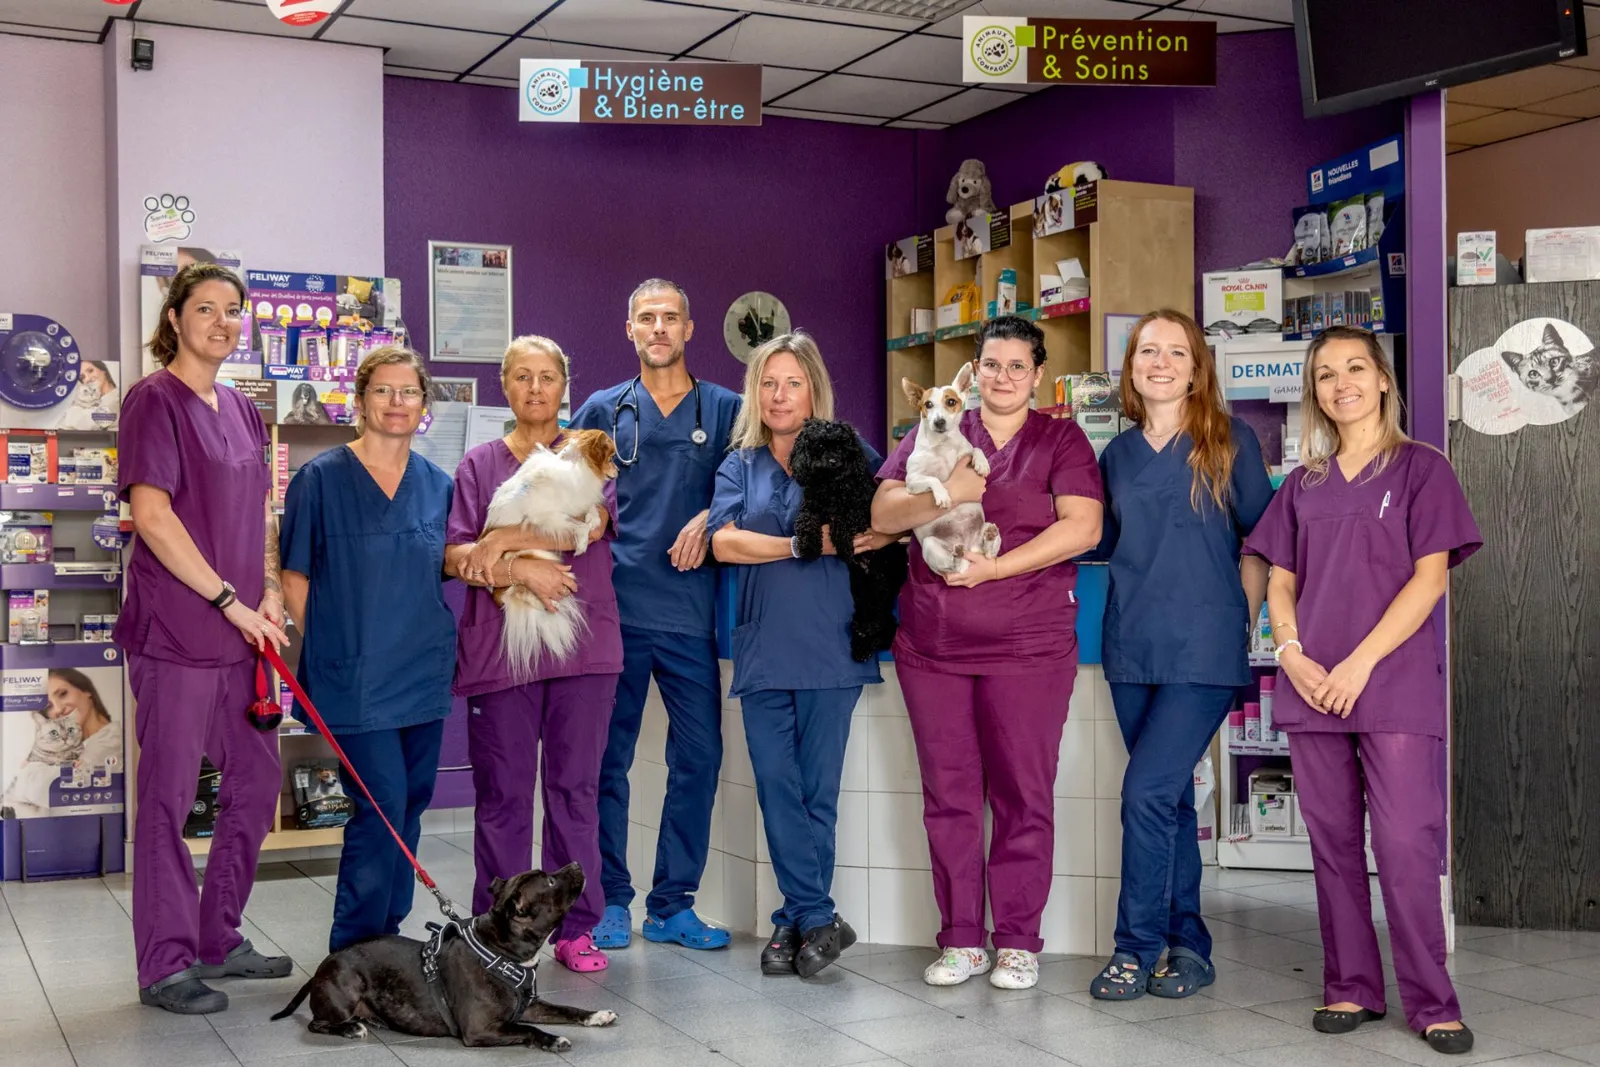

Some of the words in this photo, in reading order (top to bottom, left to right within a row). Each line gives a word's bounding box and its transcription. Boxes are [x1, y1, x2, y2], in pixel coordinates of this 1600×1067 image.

[975, 29, 1007, 48] ANIMAUX
[1043, 26, 1188, 52] Prévention
[976, 56, 1014, 72] COMPAGNIE
[1043, 55, 1062, 79] &
[1075, 55, 1149, 80] Soins
[531, 71, 561, 89] ANIMAUX
[595, 68, 704, 98] Hygiène
[531, 97, 567, 112] COMPAGNIE
[594, 95, 613, 118] &
[624, 96, 745, 120] Bien-être
[1328, 159, 1359, 177] NOUVELLES
[249, 273, 291, 282] FELIWAY
[1221, 284, 1244, 292] ROYAL
[1245, 283, 1268, 291] CANIN
[269, 366, 305, 375] FWAY
[1232, 362, 1304, 378] DERMAT
[1273, 386, 1302, 394] GAMM
[3, 676, 42, 684] FELIWAY
